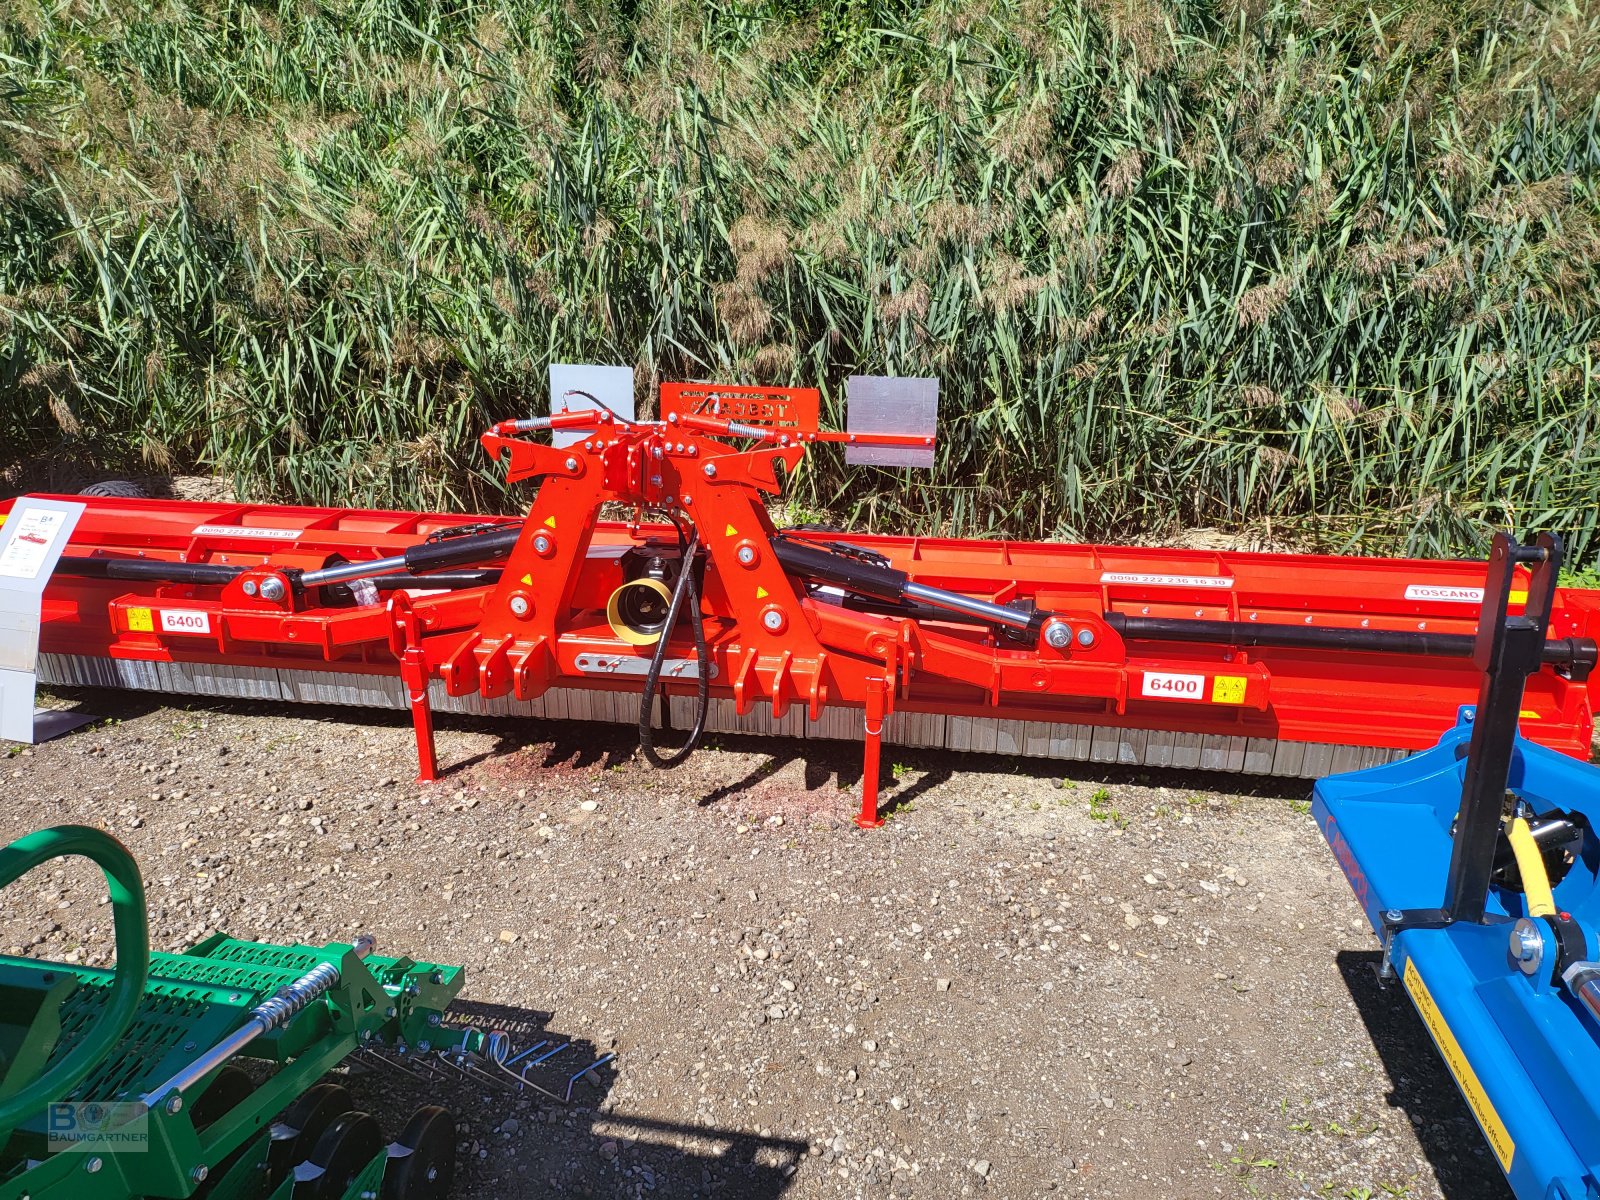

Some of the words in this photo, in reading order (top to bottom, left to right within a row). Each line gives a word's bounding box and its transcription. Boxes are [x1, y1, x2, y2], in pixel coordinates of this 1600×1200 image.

[1411, 588, 1479, 598] TOSCANO
[167, 615, 203, 628] 6400
[1150, 678, 1197, 693] 6400
[1421, 1002, 1432, 1021] nach
[1431, 1019, 1453, 1061] Benutzen
[1452, 1060, 1463, 1077] den
[1462, 1074, 1488, 1126] Verschluss
[1487, 1125, 1509, 1163] öffnen!
